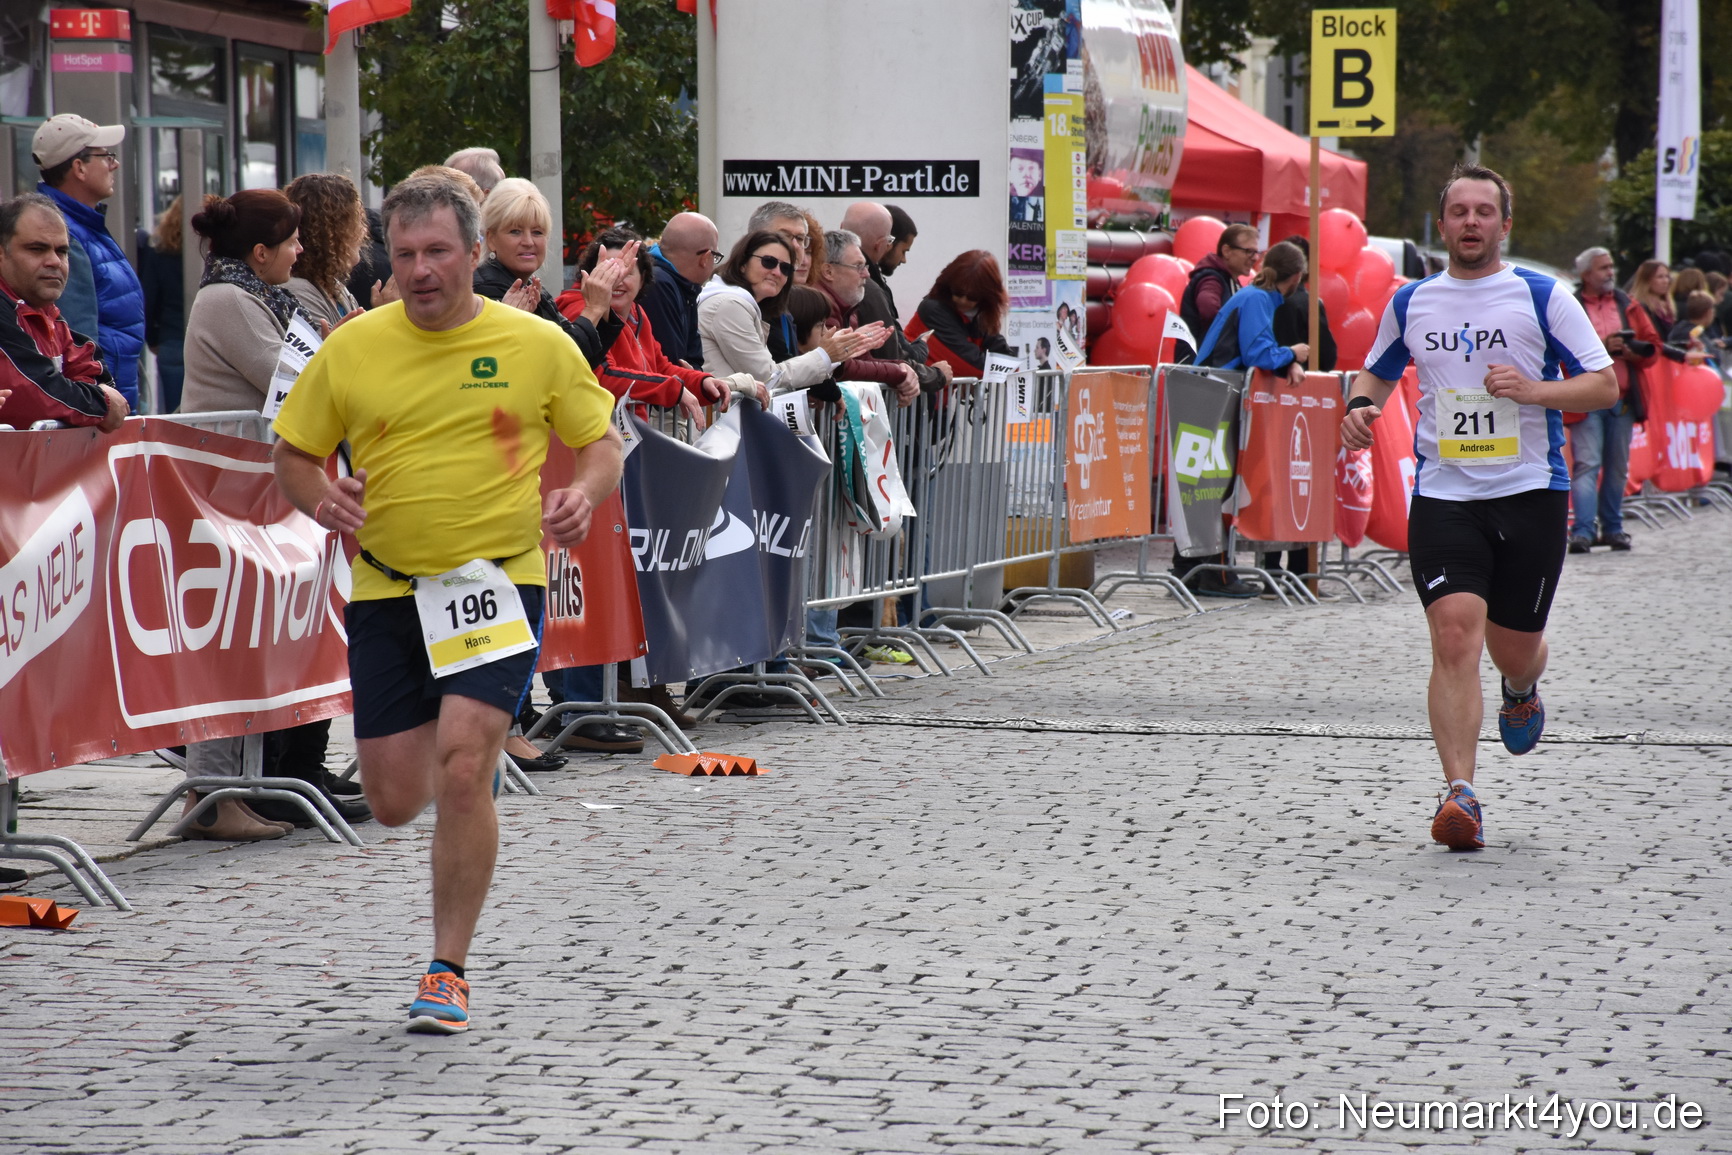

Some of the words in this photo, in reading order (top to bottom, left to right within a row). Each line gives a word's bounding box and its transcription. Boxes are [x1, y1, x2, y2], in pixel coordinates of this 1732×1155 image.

[1026, 11, 1043, 27] CUP
[1322, 14, 1386, 37] Block
[63, 54, 103, 67] HotSpot
[1332, 48, 1374, 109] B
[1048, 113, 1071, 136] 18.
[724, 164, 970, 193] www.MINI-Partl.de
[459, 382, 482, 390] JOHN
[1017, 376, 1026, 405] swn
[785, 402, 799, 430] swn
[1453, 410, 1495, 435] 211
[1459, 443, 1495, 452] Andreas
[34, 521, 84, 634] NEUE
[548, 547, 584, 620] Hits
[444, 588, 498, 630] 196
[464, 634, 492, 650] Hans
